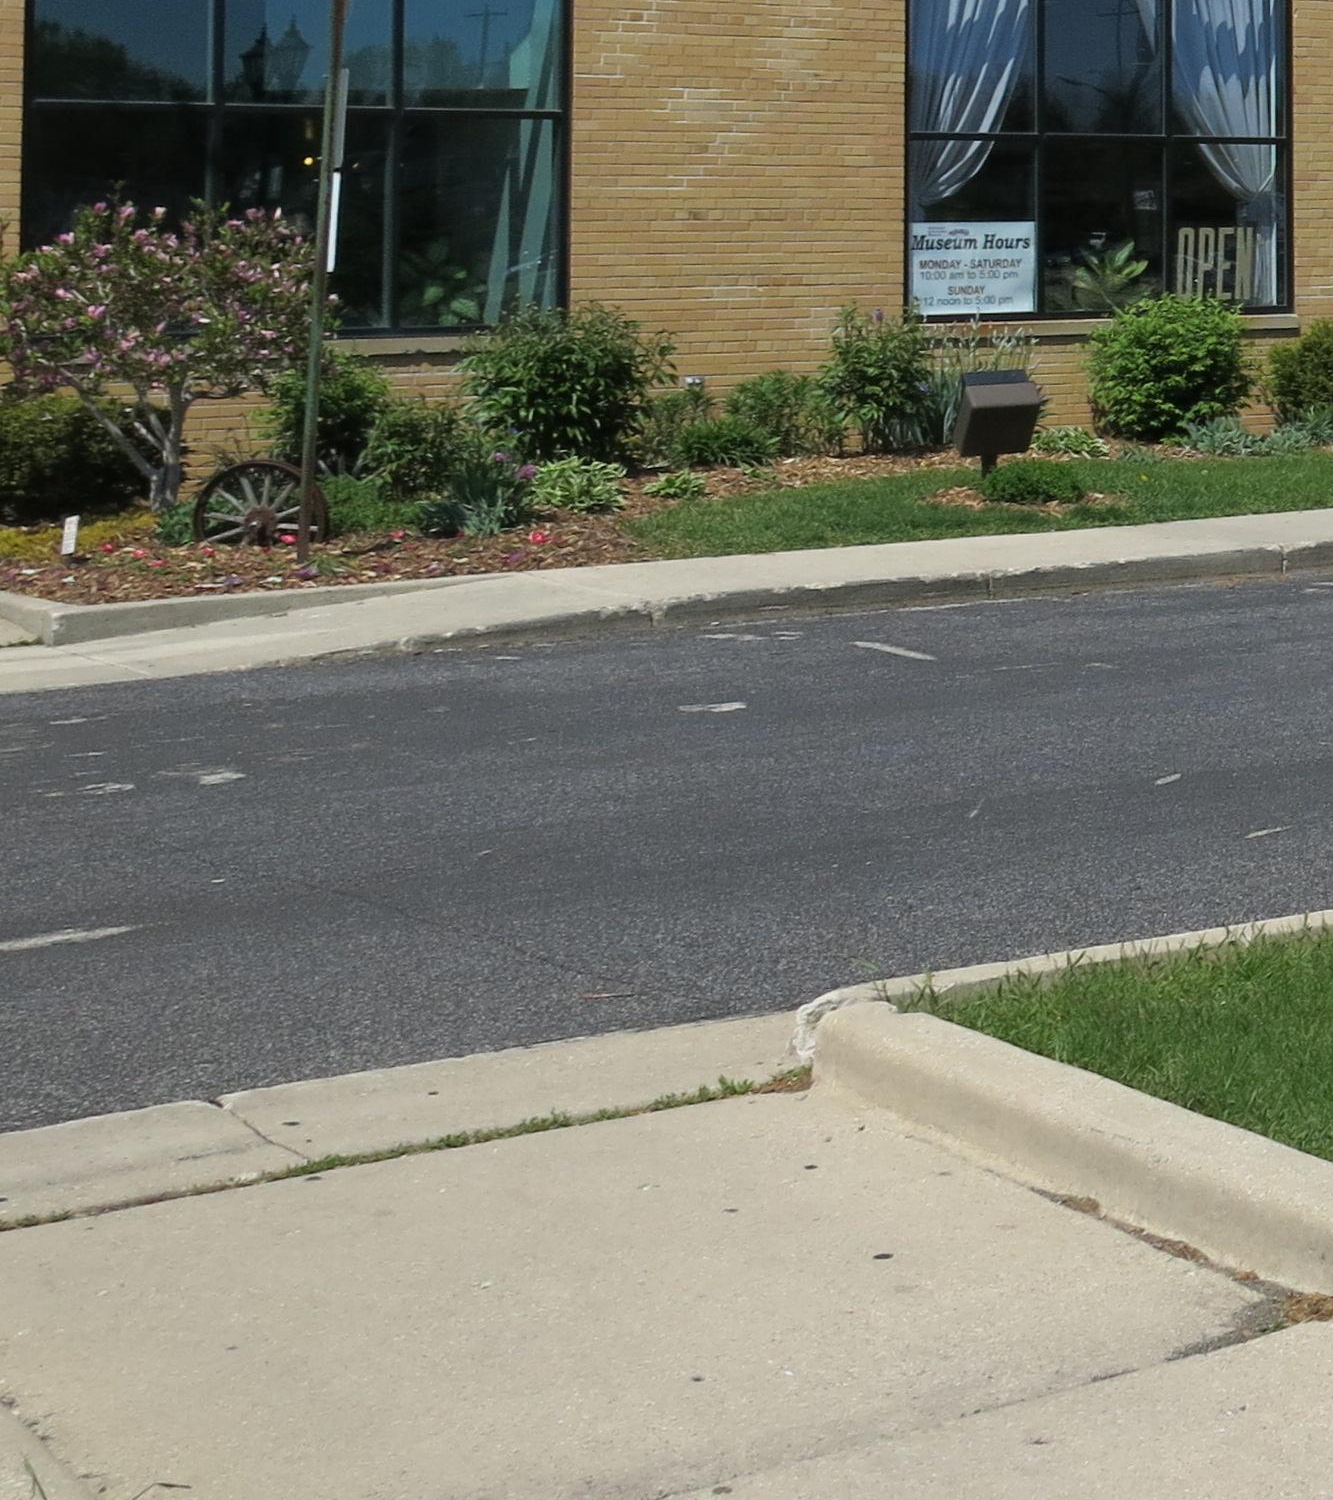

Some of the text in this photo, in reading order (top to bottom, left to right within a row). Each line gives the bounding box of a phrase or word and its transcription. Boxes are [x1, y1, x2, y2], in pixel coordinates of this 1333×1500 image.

[911, 233, 1031, 251] Museum Hours
[919, 260, 961, 270] MONDAY
[970, 259, 1022, 269] SATURDAY
[1176, 227, 1254, 301] OPEN
[948, 286, 985, 296] SUNDAY
